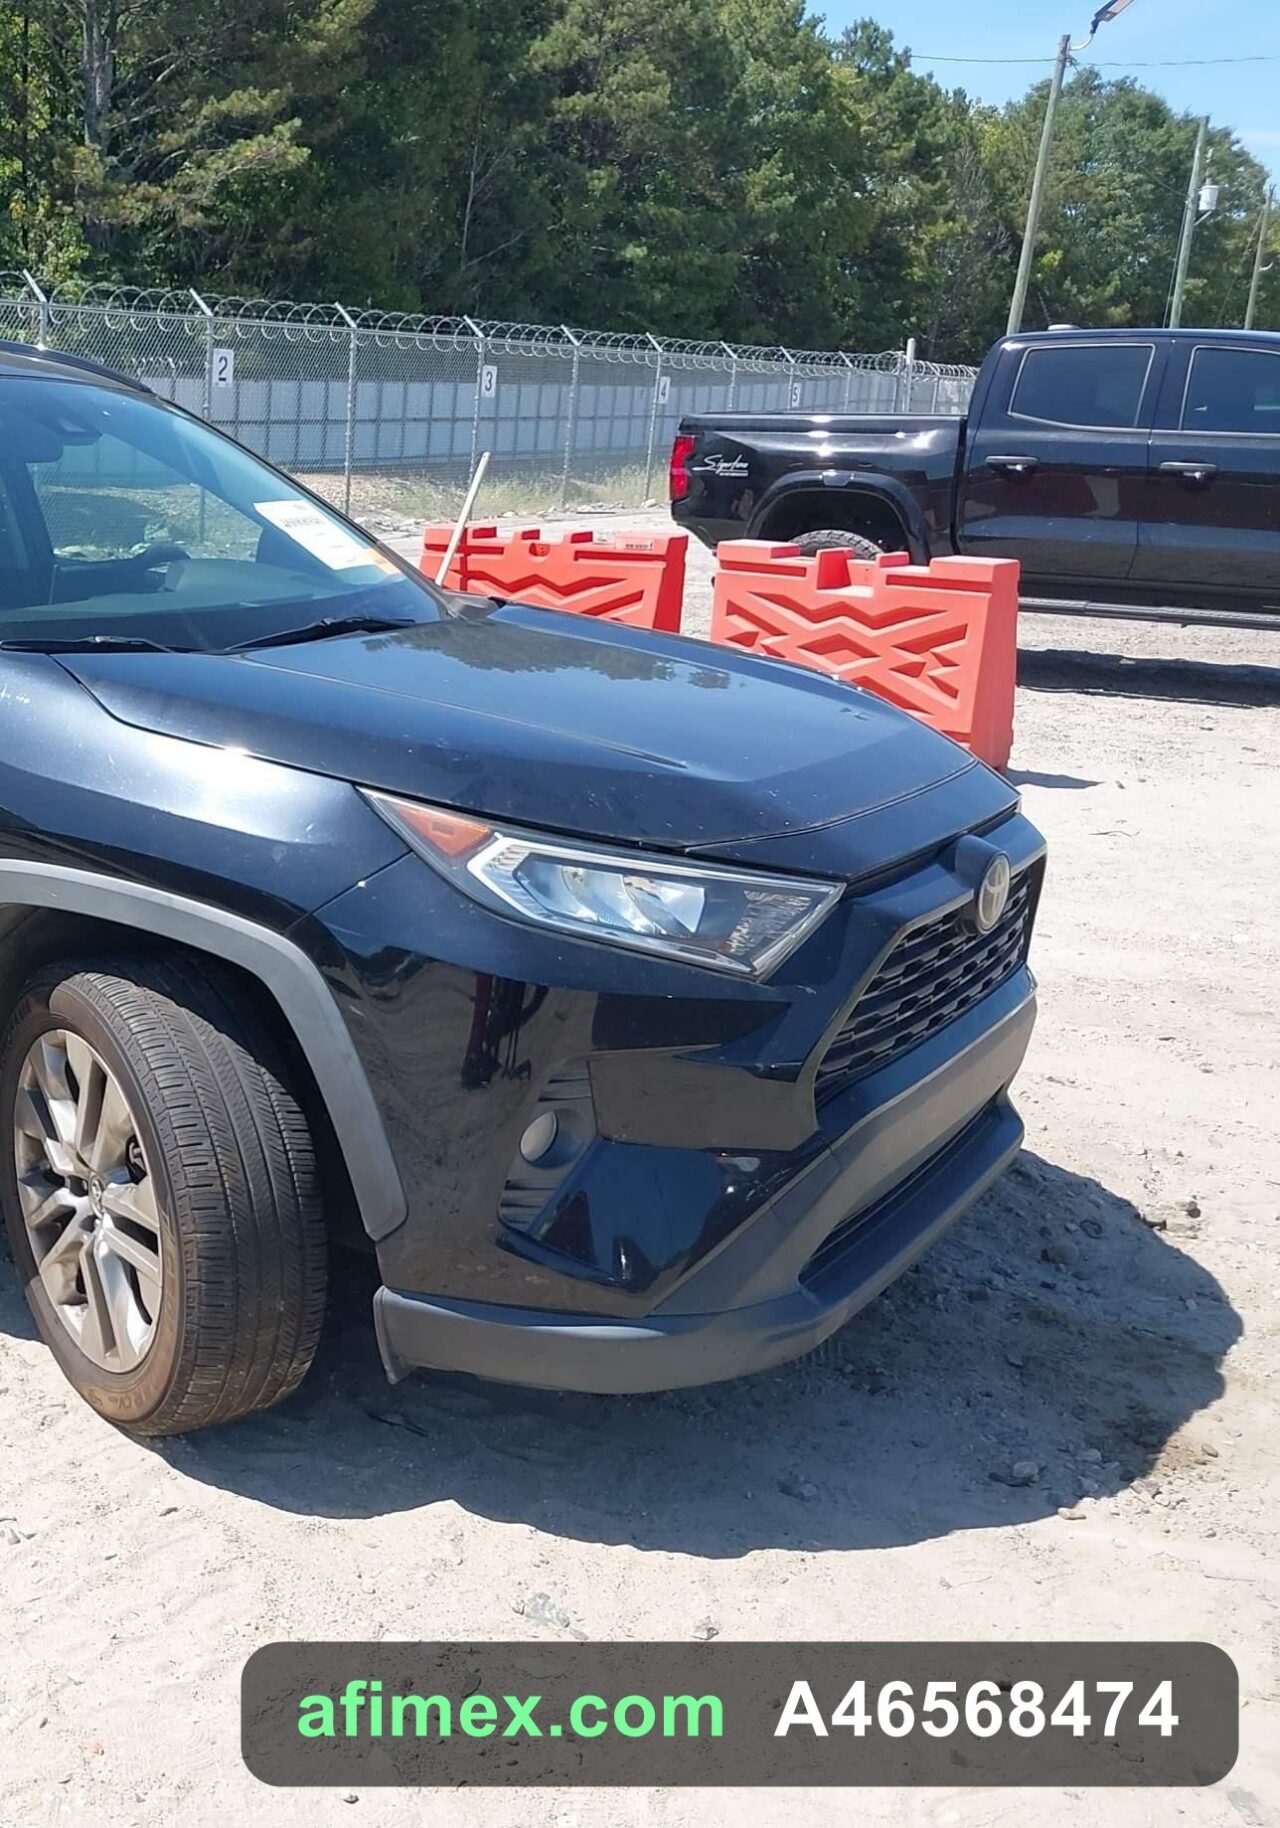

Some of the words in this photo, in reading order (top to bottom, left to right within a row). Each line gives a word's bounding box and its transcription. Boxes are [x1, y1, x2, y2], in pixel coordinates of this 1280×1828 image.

[218, 356, 228, 382] 2
[484, 371, 493, 393] 3
[660, 382, 667, 399] 4
[792, 387, 798, 402] 5
